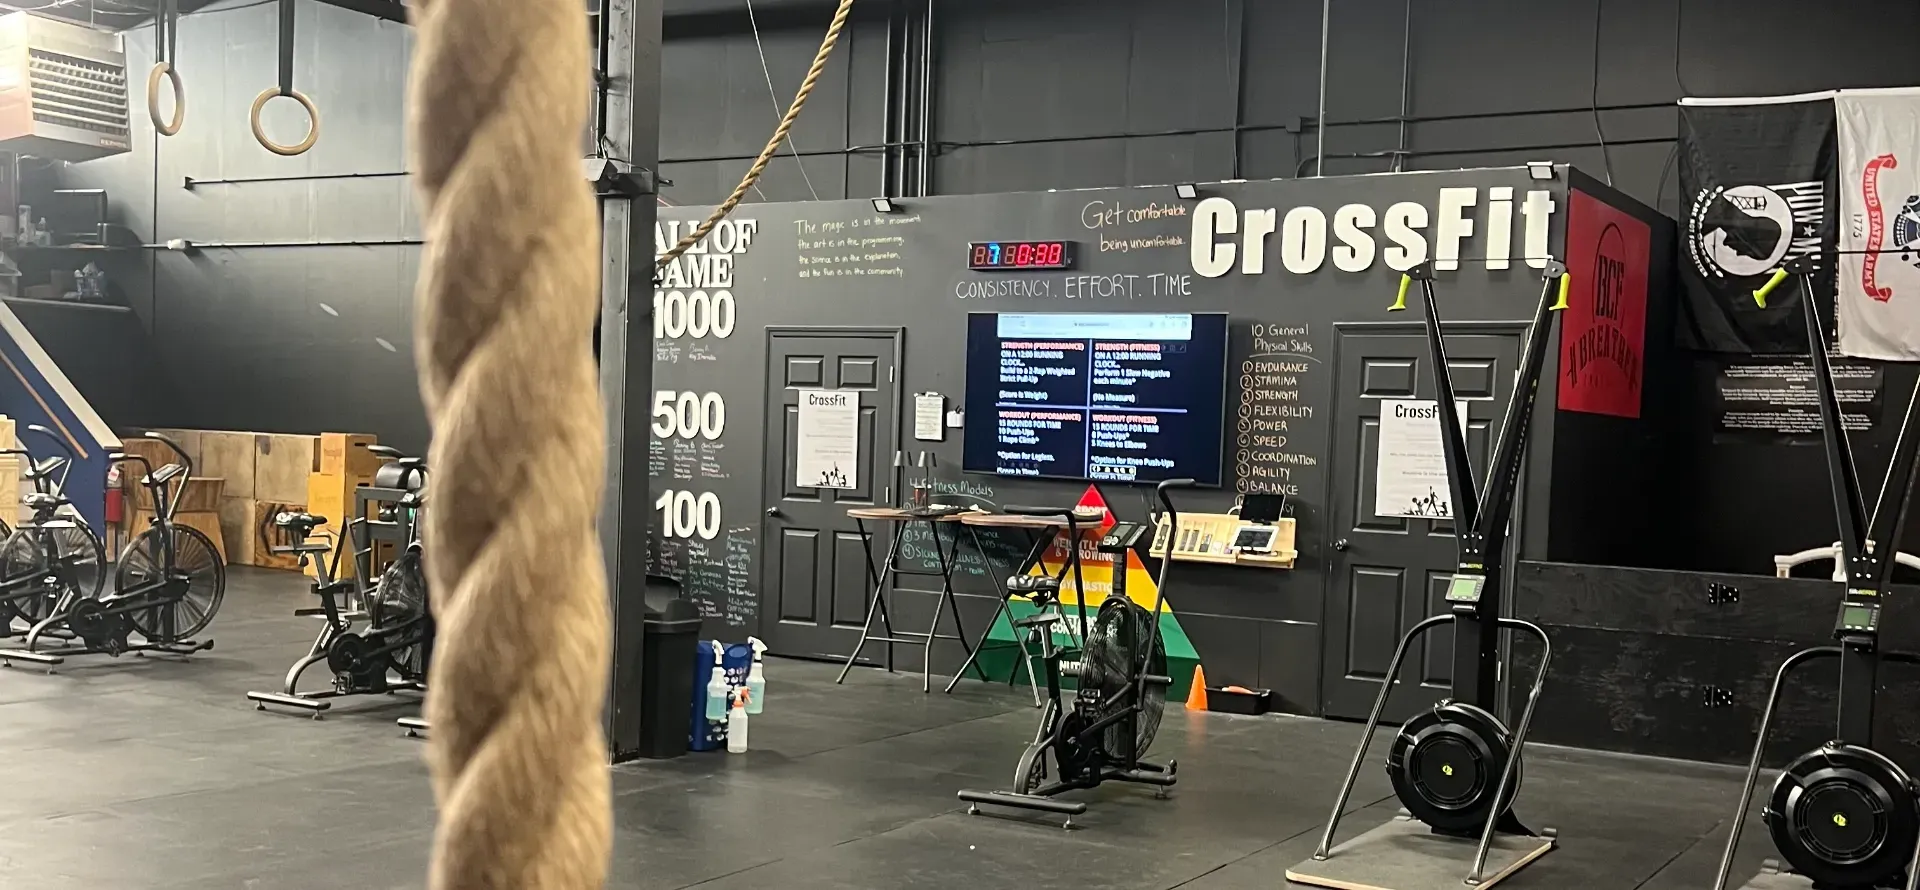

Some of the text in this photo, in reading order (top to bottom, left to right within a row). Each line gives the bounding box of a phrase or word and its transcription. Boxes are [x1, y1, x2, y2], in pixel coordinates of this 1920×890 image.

[1865, 167, 1877, 207] UNITED
[1081, 201, 1187, 229] Get comfortable
[793, 219, 816, 236] The
[852, 219, 859, 227] is
[874, 216, 885, 225] the
[1853, 213, 1864, 238] 1775
[1869, 211, 1881, 251] STATES
[713, 219, 757, 254] OF
[1190, 187, 1555, 278] CrossFit
[798, 239, 810, 249] the
[814, 239, 827, 248] art
[829, 240, 834, 248] is
[838, 239, 845, 247] in
[847, 238, 859, 246] the
[1100, 233, 1128, 253] being
[799, 255, 809, 264] the
[835, 255, 840, 263] is
[850, 254, 861, 262] the
[799, 268, 810, 278] and
[813, 269, 821, 277] the
[824, 268, 834, 276] fun
[837, 268, 843, 276] is
[854, 267, 865, 275] the
[1864, 254, 1876, 288] ARMY
[1147, 273, 1192, 297] TIME
[653, 290, 736, 339] 1000
[1251, 323, 1309, 337] 10 General
[1001, 341, 1084, 351] STRENGTH (PERFORMANCE)
[1095, 343, 1160, 352] STRENGTH (FITNESS)
[1254, 339, 1313, 354] Physical Skills
[1001, 350, 1011, 358] ON
[1011, 350, 1017, 358] A
[1034, 351, 1064, 359] RUNNING
[1095, 352, 1106, 360] ON
[1106, 352, 1112, 360] A
[1130, 352, 1161, 360] RUNNING
[1094, 368, 1120, 377] Perform
[1141, 369, 1170, 379] Negative
[1255, 361, 1308, 373] ENDURANCE
[1255, 376, 1297, 387] STAMINA
[809, 394, 847, 407] CrossFit
[1255, 390, 1298, 401] STRENGTH
[652, 390, 726, 440] 500
[999, 411, 1081, 421] WORKOUT (PERFORMANCE)
[1254, 406, 1313, 418] FLEXIBILITY
[1395, 404, 1439, 419] CrossF
[1007, 420, 1032, 428] ROUNDS
[1033, 420, 1046, 428] FOR
[1046, 421, 1062, 429] TIME
[1092, 414, 1157, 424] WORKOUT (FITNESS)
[1253, 420, 1288, 431] POWER
[1101, 423, 1128, 431] ROUNDS
[1129, 424, 1142, 432] FOR
[1143, 425, 1159, 433] TIME
[1253, 435, 1287, 448] SPEED
[1251, 452, 1317, 467] COORDINATION
[1252, 466, 1290, 481] AGILITY
[960, 480, 994, 497] Models
[1250, 480, 1298, 497] BALANCE
[656, 490, 721, 540] 100
[1055, 548, 1061, 557] &
